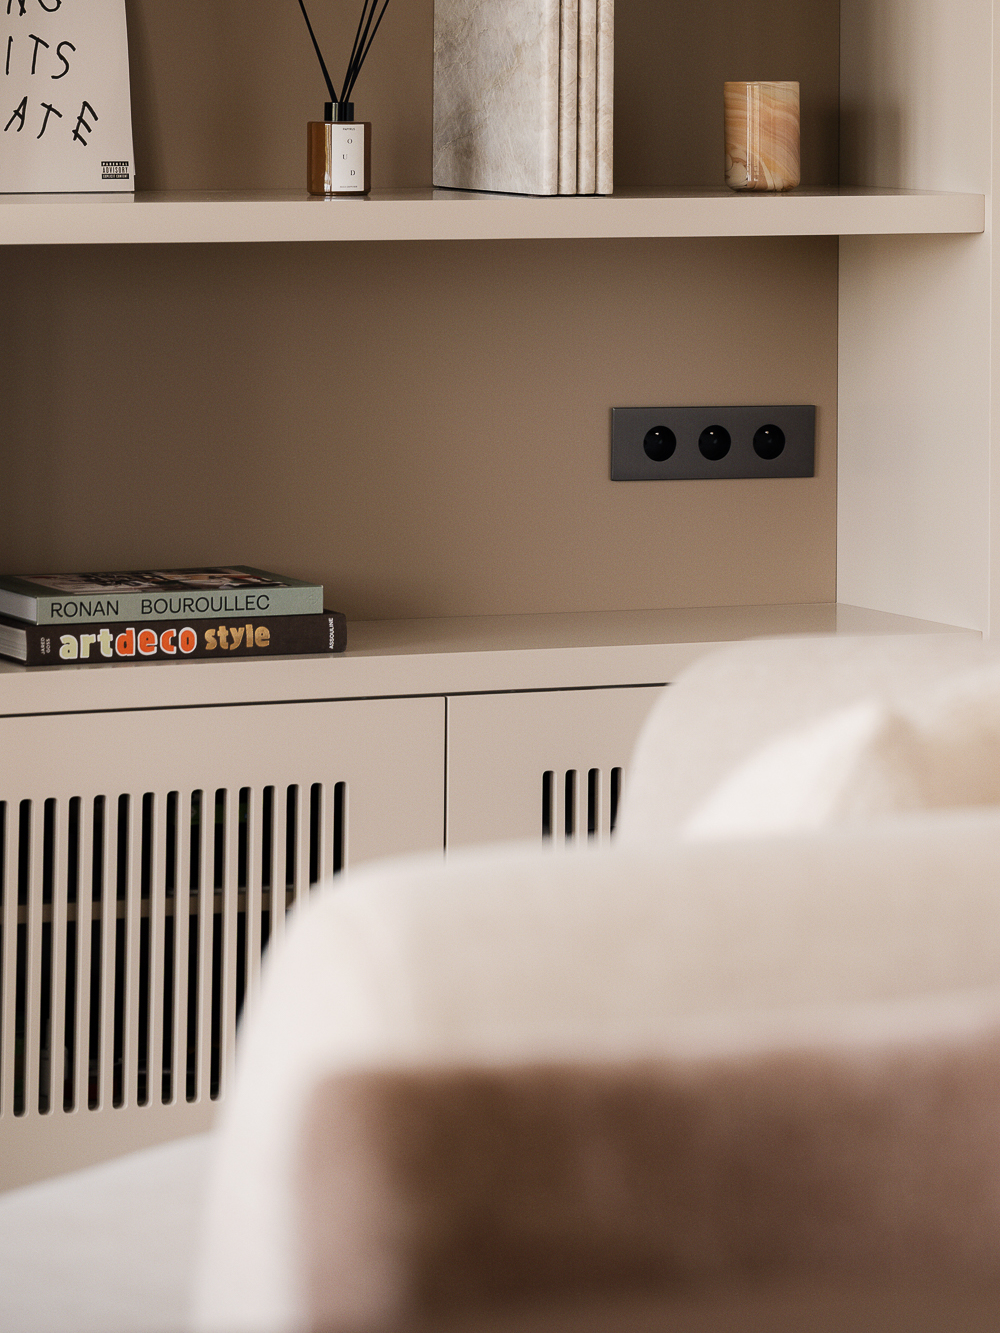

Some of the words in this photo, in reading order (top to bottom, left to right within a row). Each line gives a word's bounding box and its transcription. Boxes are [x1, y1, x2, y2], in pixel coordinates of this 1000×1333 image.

[6, 34, 76, 79] ITS
[4, 96, 98, 146] ATE
[50, 600, 119, 618] RONAN
[140, 595, 270, 615] BOUROULLEC
[204, 624, 271, 651] style
